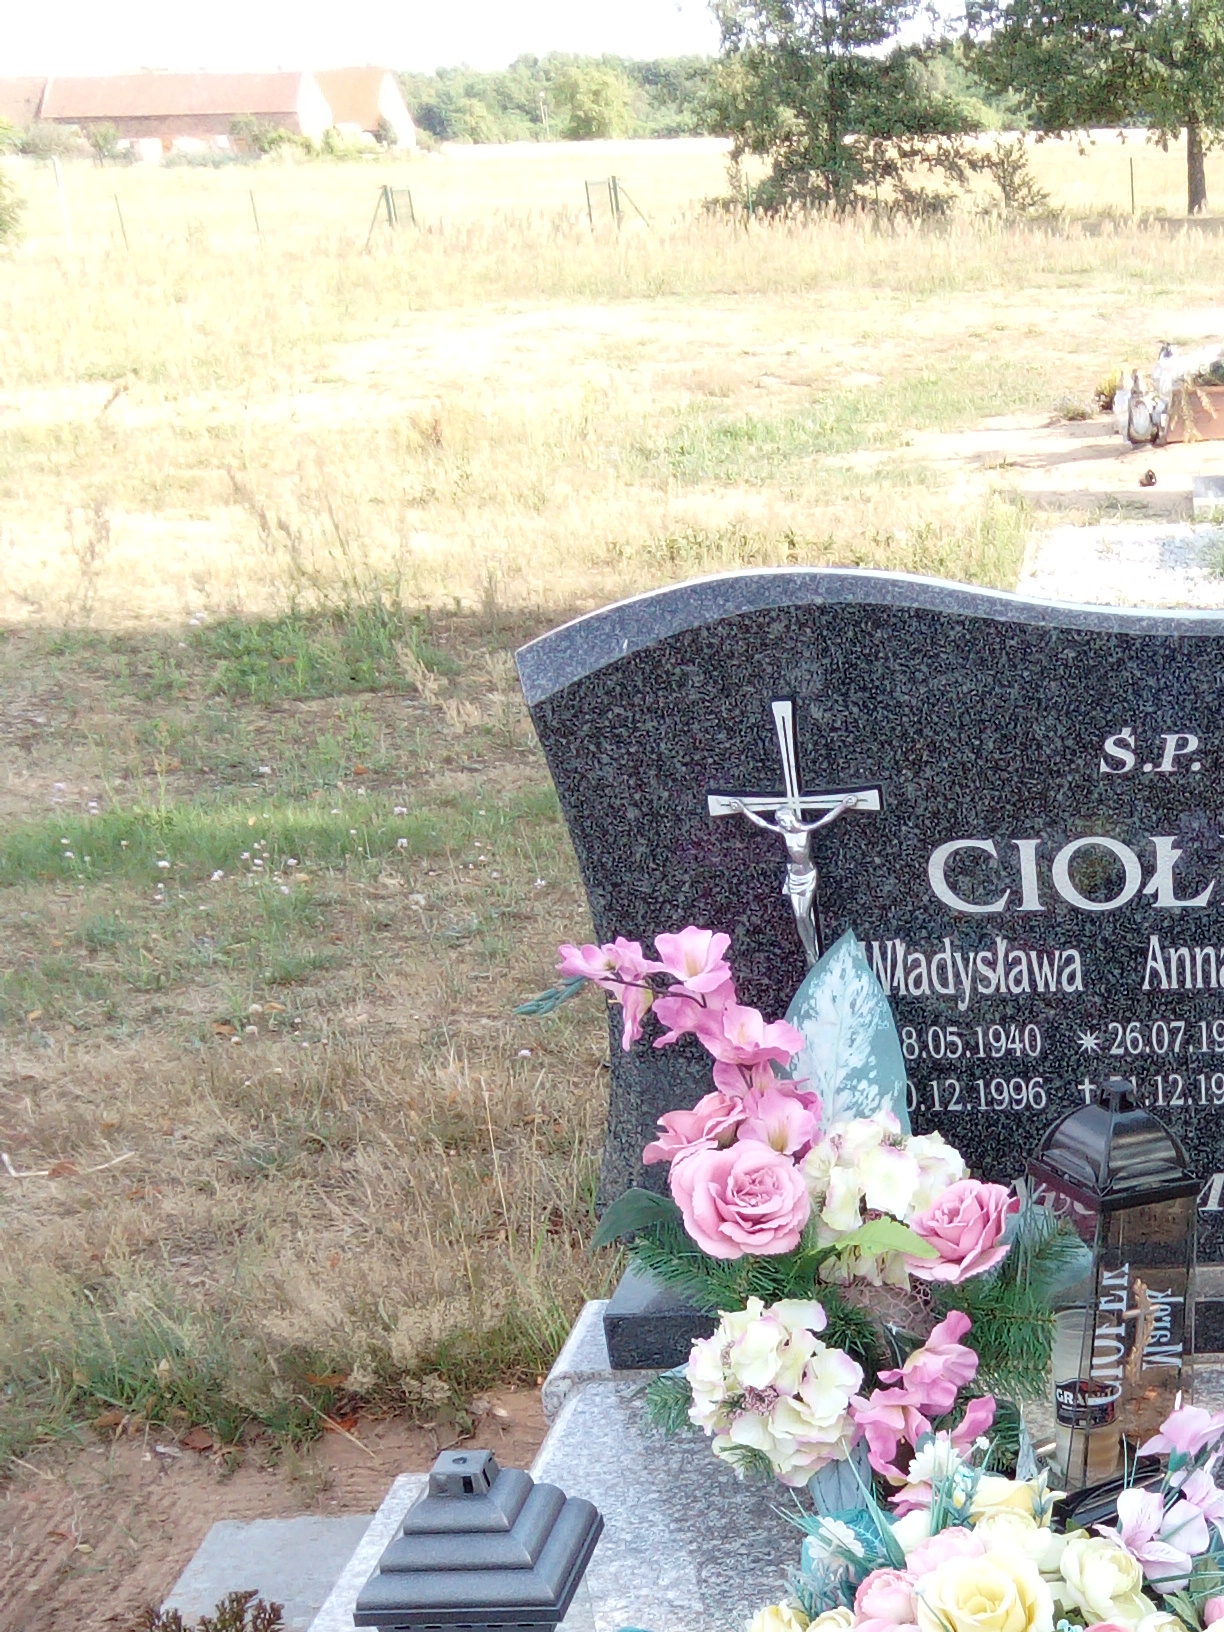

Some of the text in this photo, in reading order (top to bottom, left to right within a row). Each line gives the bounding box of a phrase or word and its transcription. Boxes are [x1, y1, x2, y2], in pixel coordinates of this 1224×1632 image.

[1100, 727, 1202, 774] Ś.P.
[902, 1023, 1042, 1060] 8.05.1940
[906, 1077, 1047, 1112] 0.12.1996
